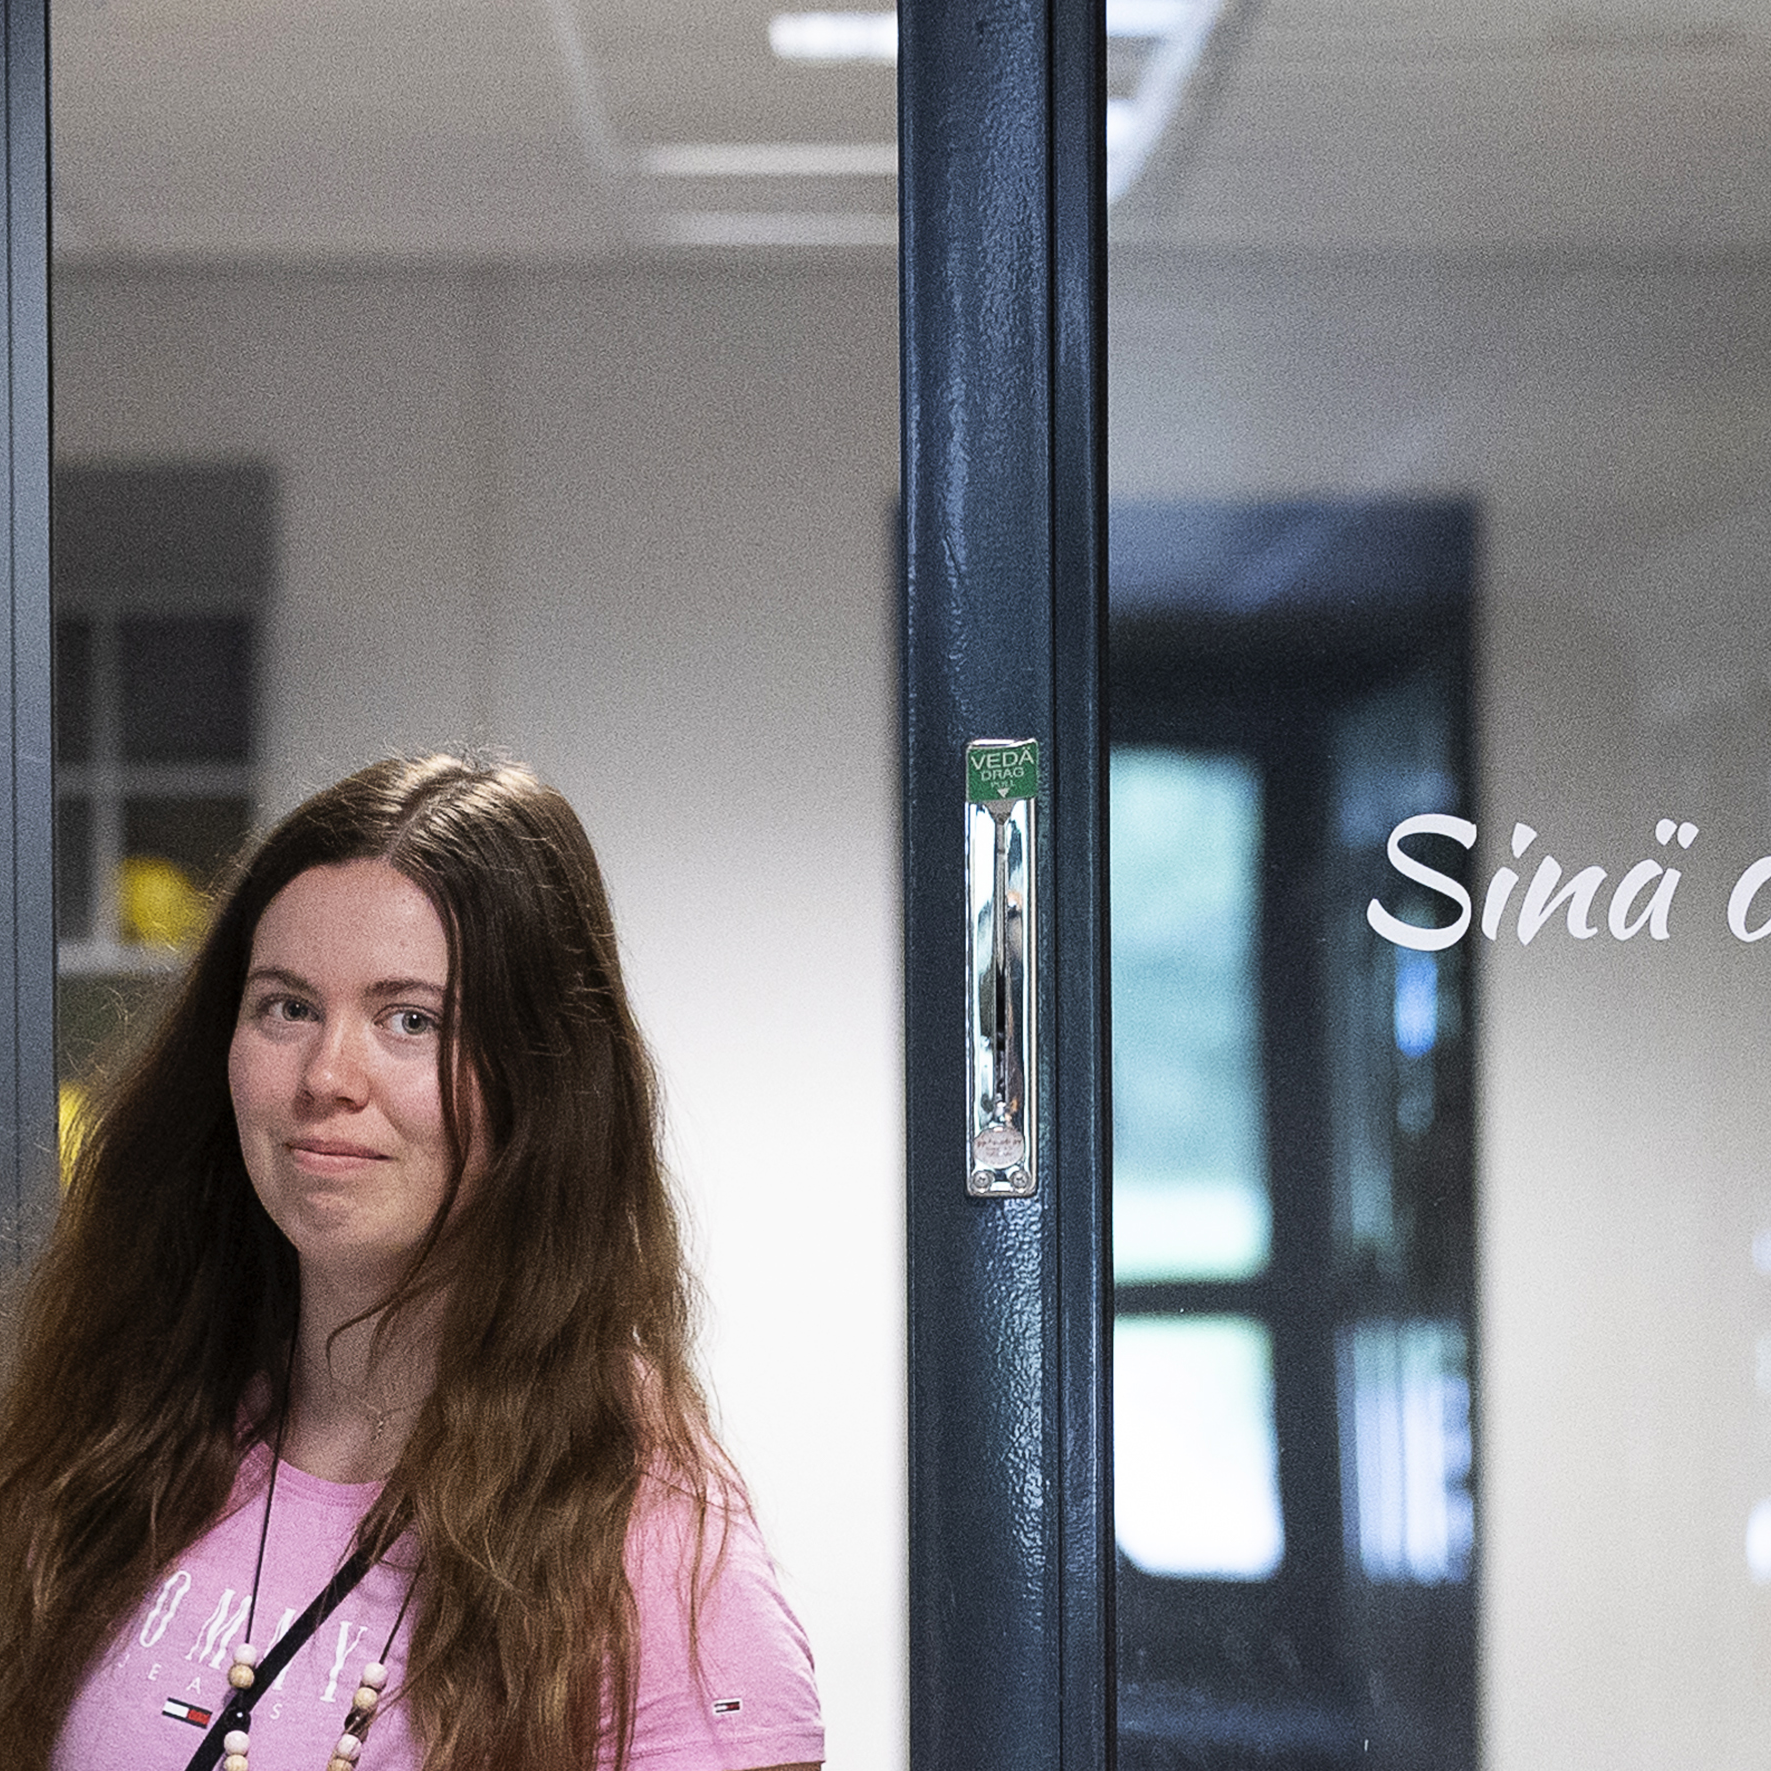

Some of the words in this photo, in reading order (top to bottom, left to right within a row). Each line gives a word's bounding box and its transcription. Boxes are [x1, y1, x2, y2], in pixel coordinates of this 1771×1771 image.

[970, 747, 1035, 770] VEDÄ
[980, 766, 1025, 782] DRAG
[1367, 813, 1699, 952] Sinä
[117, 1653, 284, 1721] JEAS
